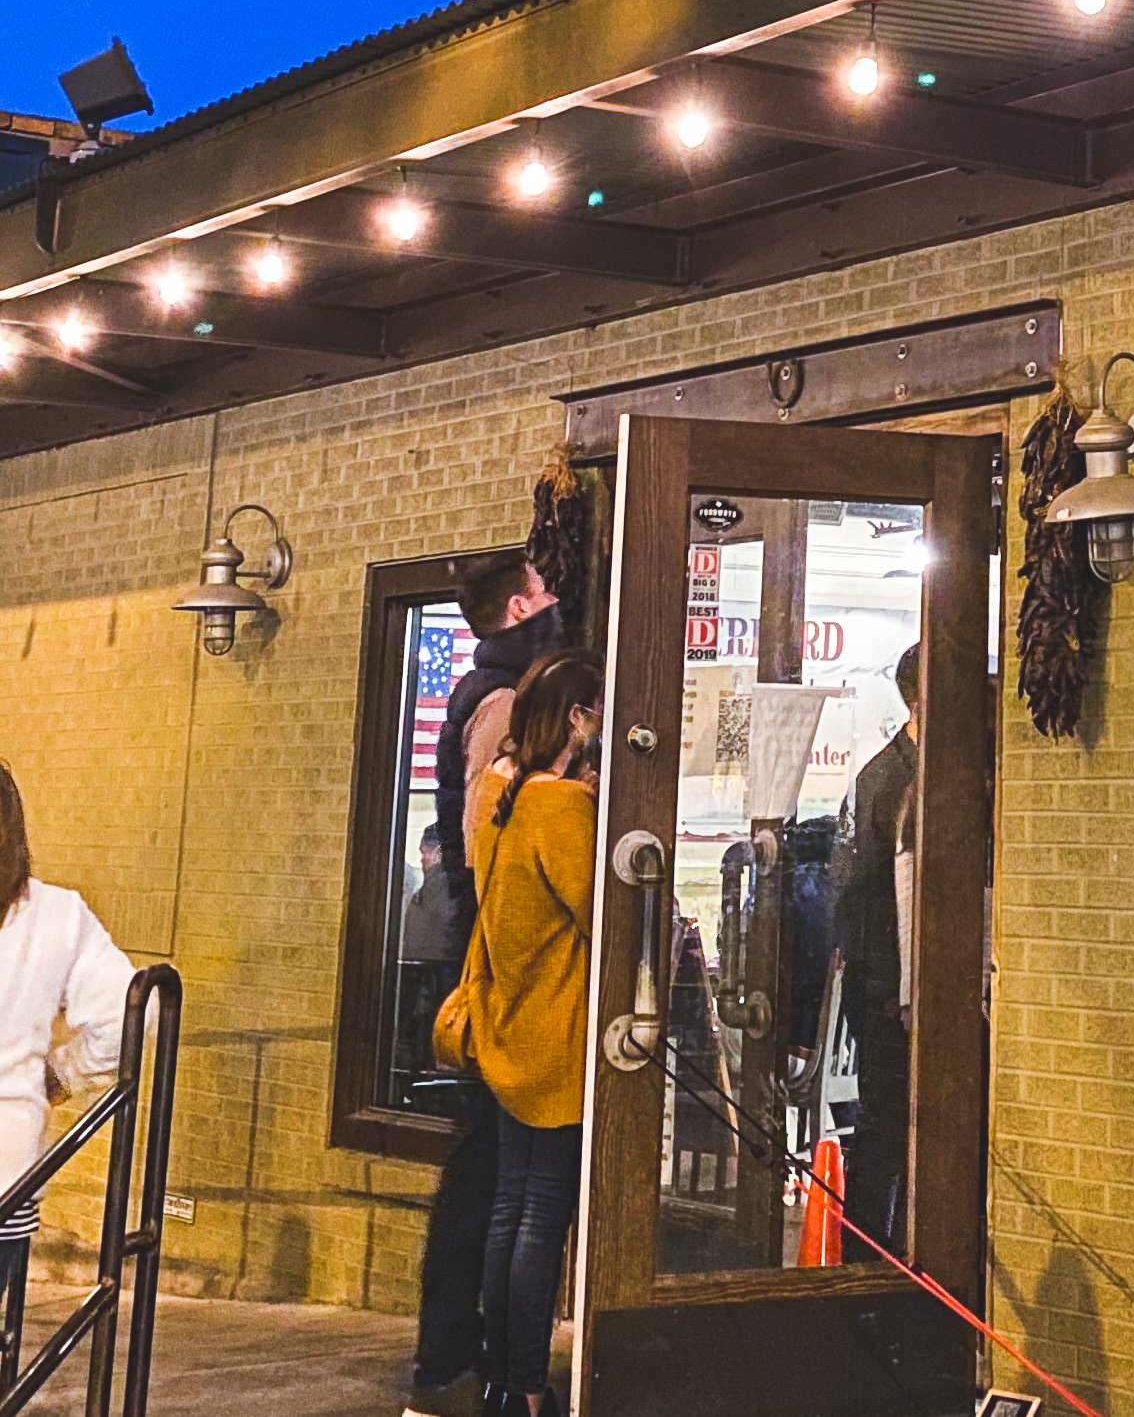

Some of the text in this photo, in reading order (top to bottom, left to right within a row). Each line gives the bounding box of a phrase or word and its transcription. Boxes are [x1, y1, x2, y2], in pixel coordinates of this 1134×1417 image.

[696, 553, 716, 573] D
[692, 579, 708, 587] BIG
[692, 592, 716, 602] 2018
[688, 606, 717, 617] BEST
[690, 619, 716, 646] D
[687, 649, 717, 661] 2019
